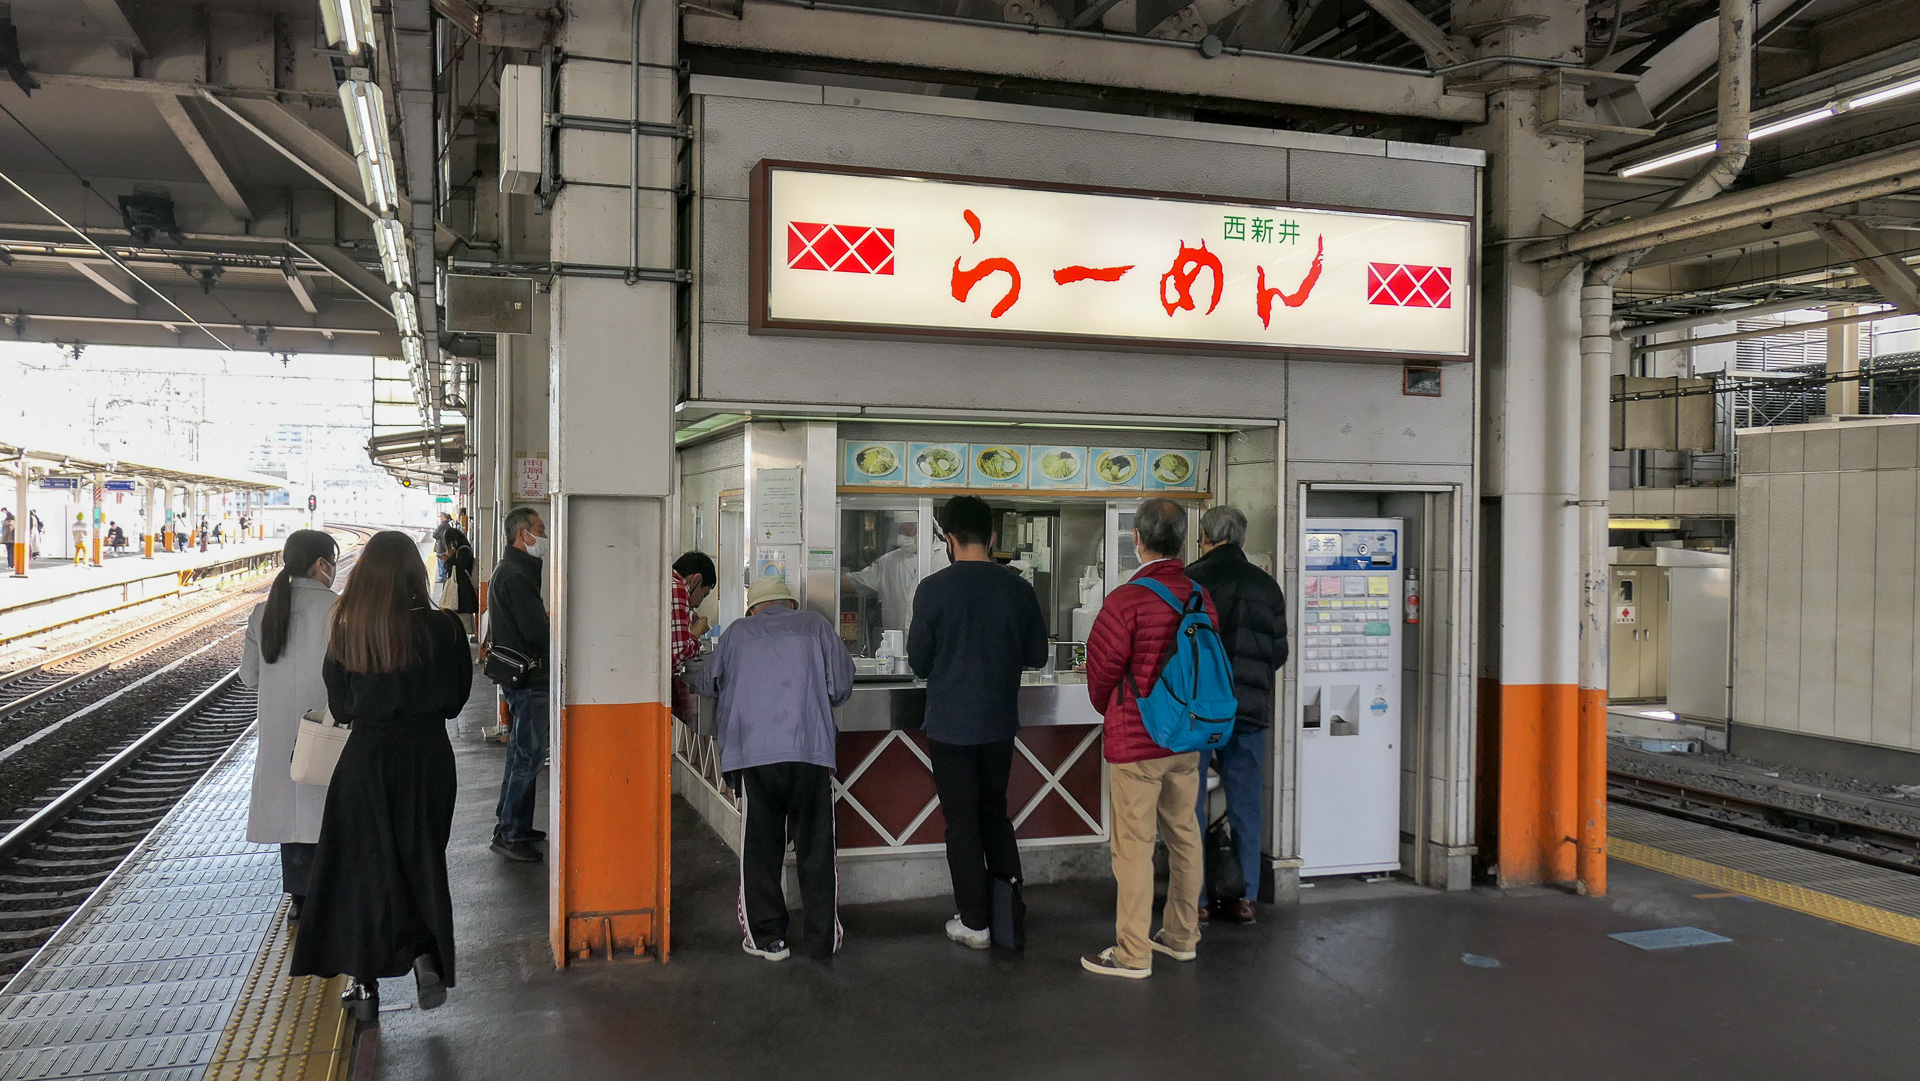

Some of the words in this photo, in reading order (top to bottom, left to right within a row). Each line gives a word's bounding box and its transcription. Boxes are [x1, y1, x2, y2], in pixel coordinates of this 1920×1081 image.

[1224, 215, 1299, 244] 西新井
[951, 209, 1323, 329] らーめん
[522, 459, 543, 497] 雨漏り注意
[1308, 536, 1335, 551] 食券
